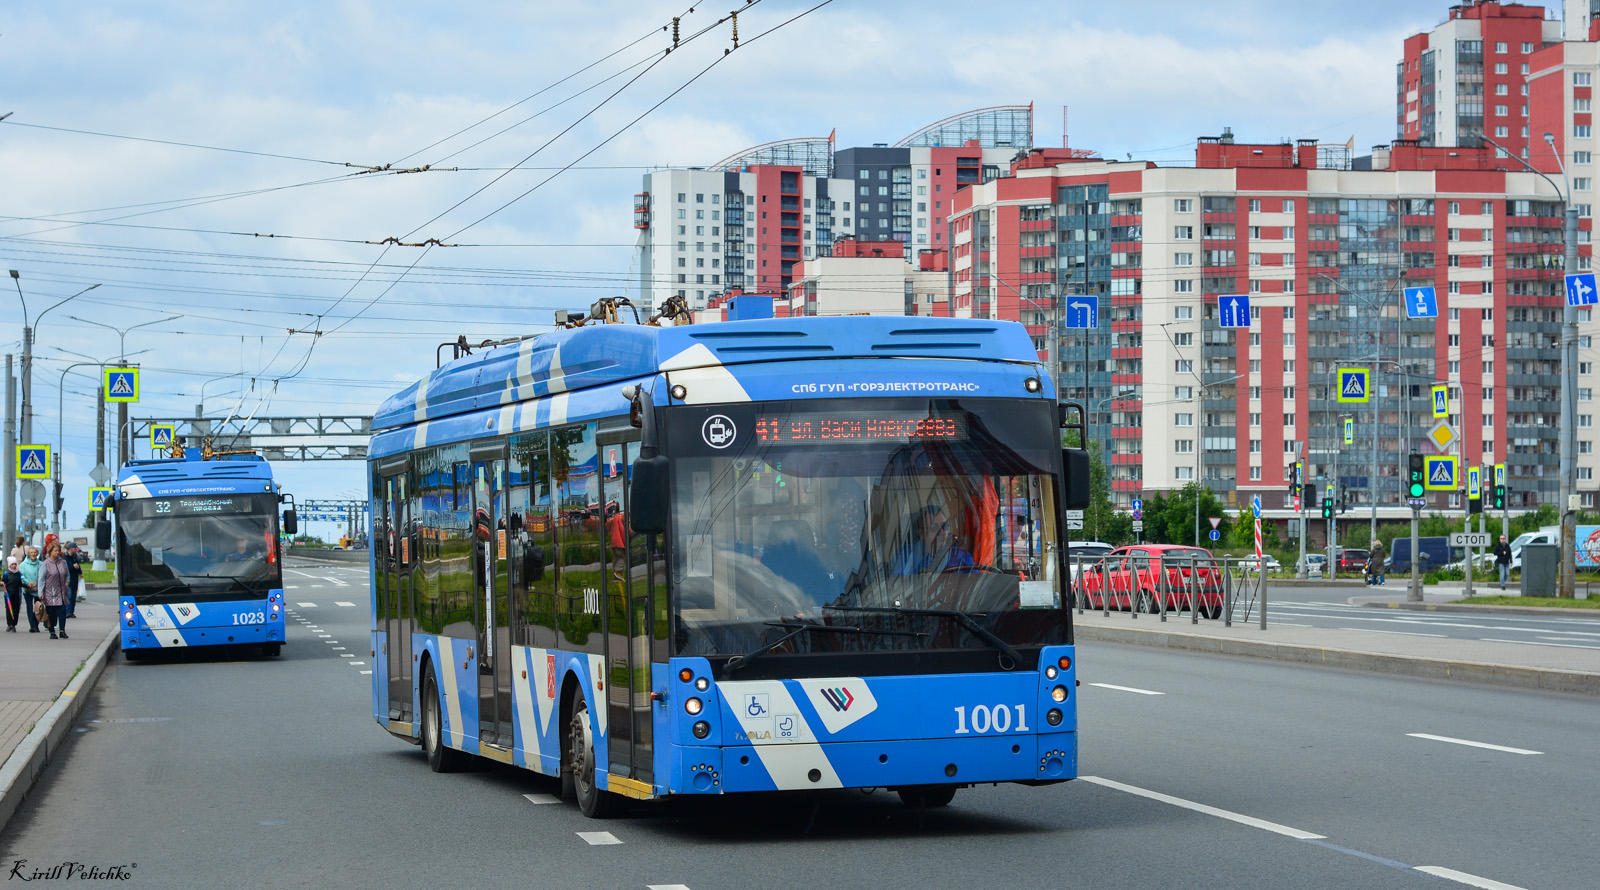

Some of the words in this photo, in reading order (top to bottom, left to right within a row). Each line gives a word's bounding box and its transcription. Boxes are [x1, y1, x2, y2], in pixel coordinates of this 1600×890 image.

[791, 384, 817, 393] СПб
[819, 383, 845, 392] ГУП
[847, 382, 980, 392] «ГОРЭЛЕКТРОТРАНС»
[755, 417, 781, 441] 41
[155, 501, 171, 513] 32
[1456, 534, 1486, 545] СТОП
[583, 588, 599, 614] 1001
[232, 612, 265, 625] 1023
[954, 704, 1030, 733] 1001
